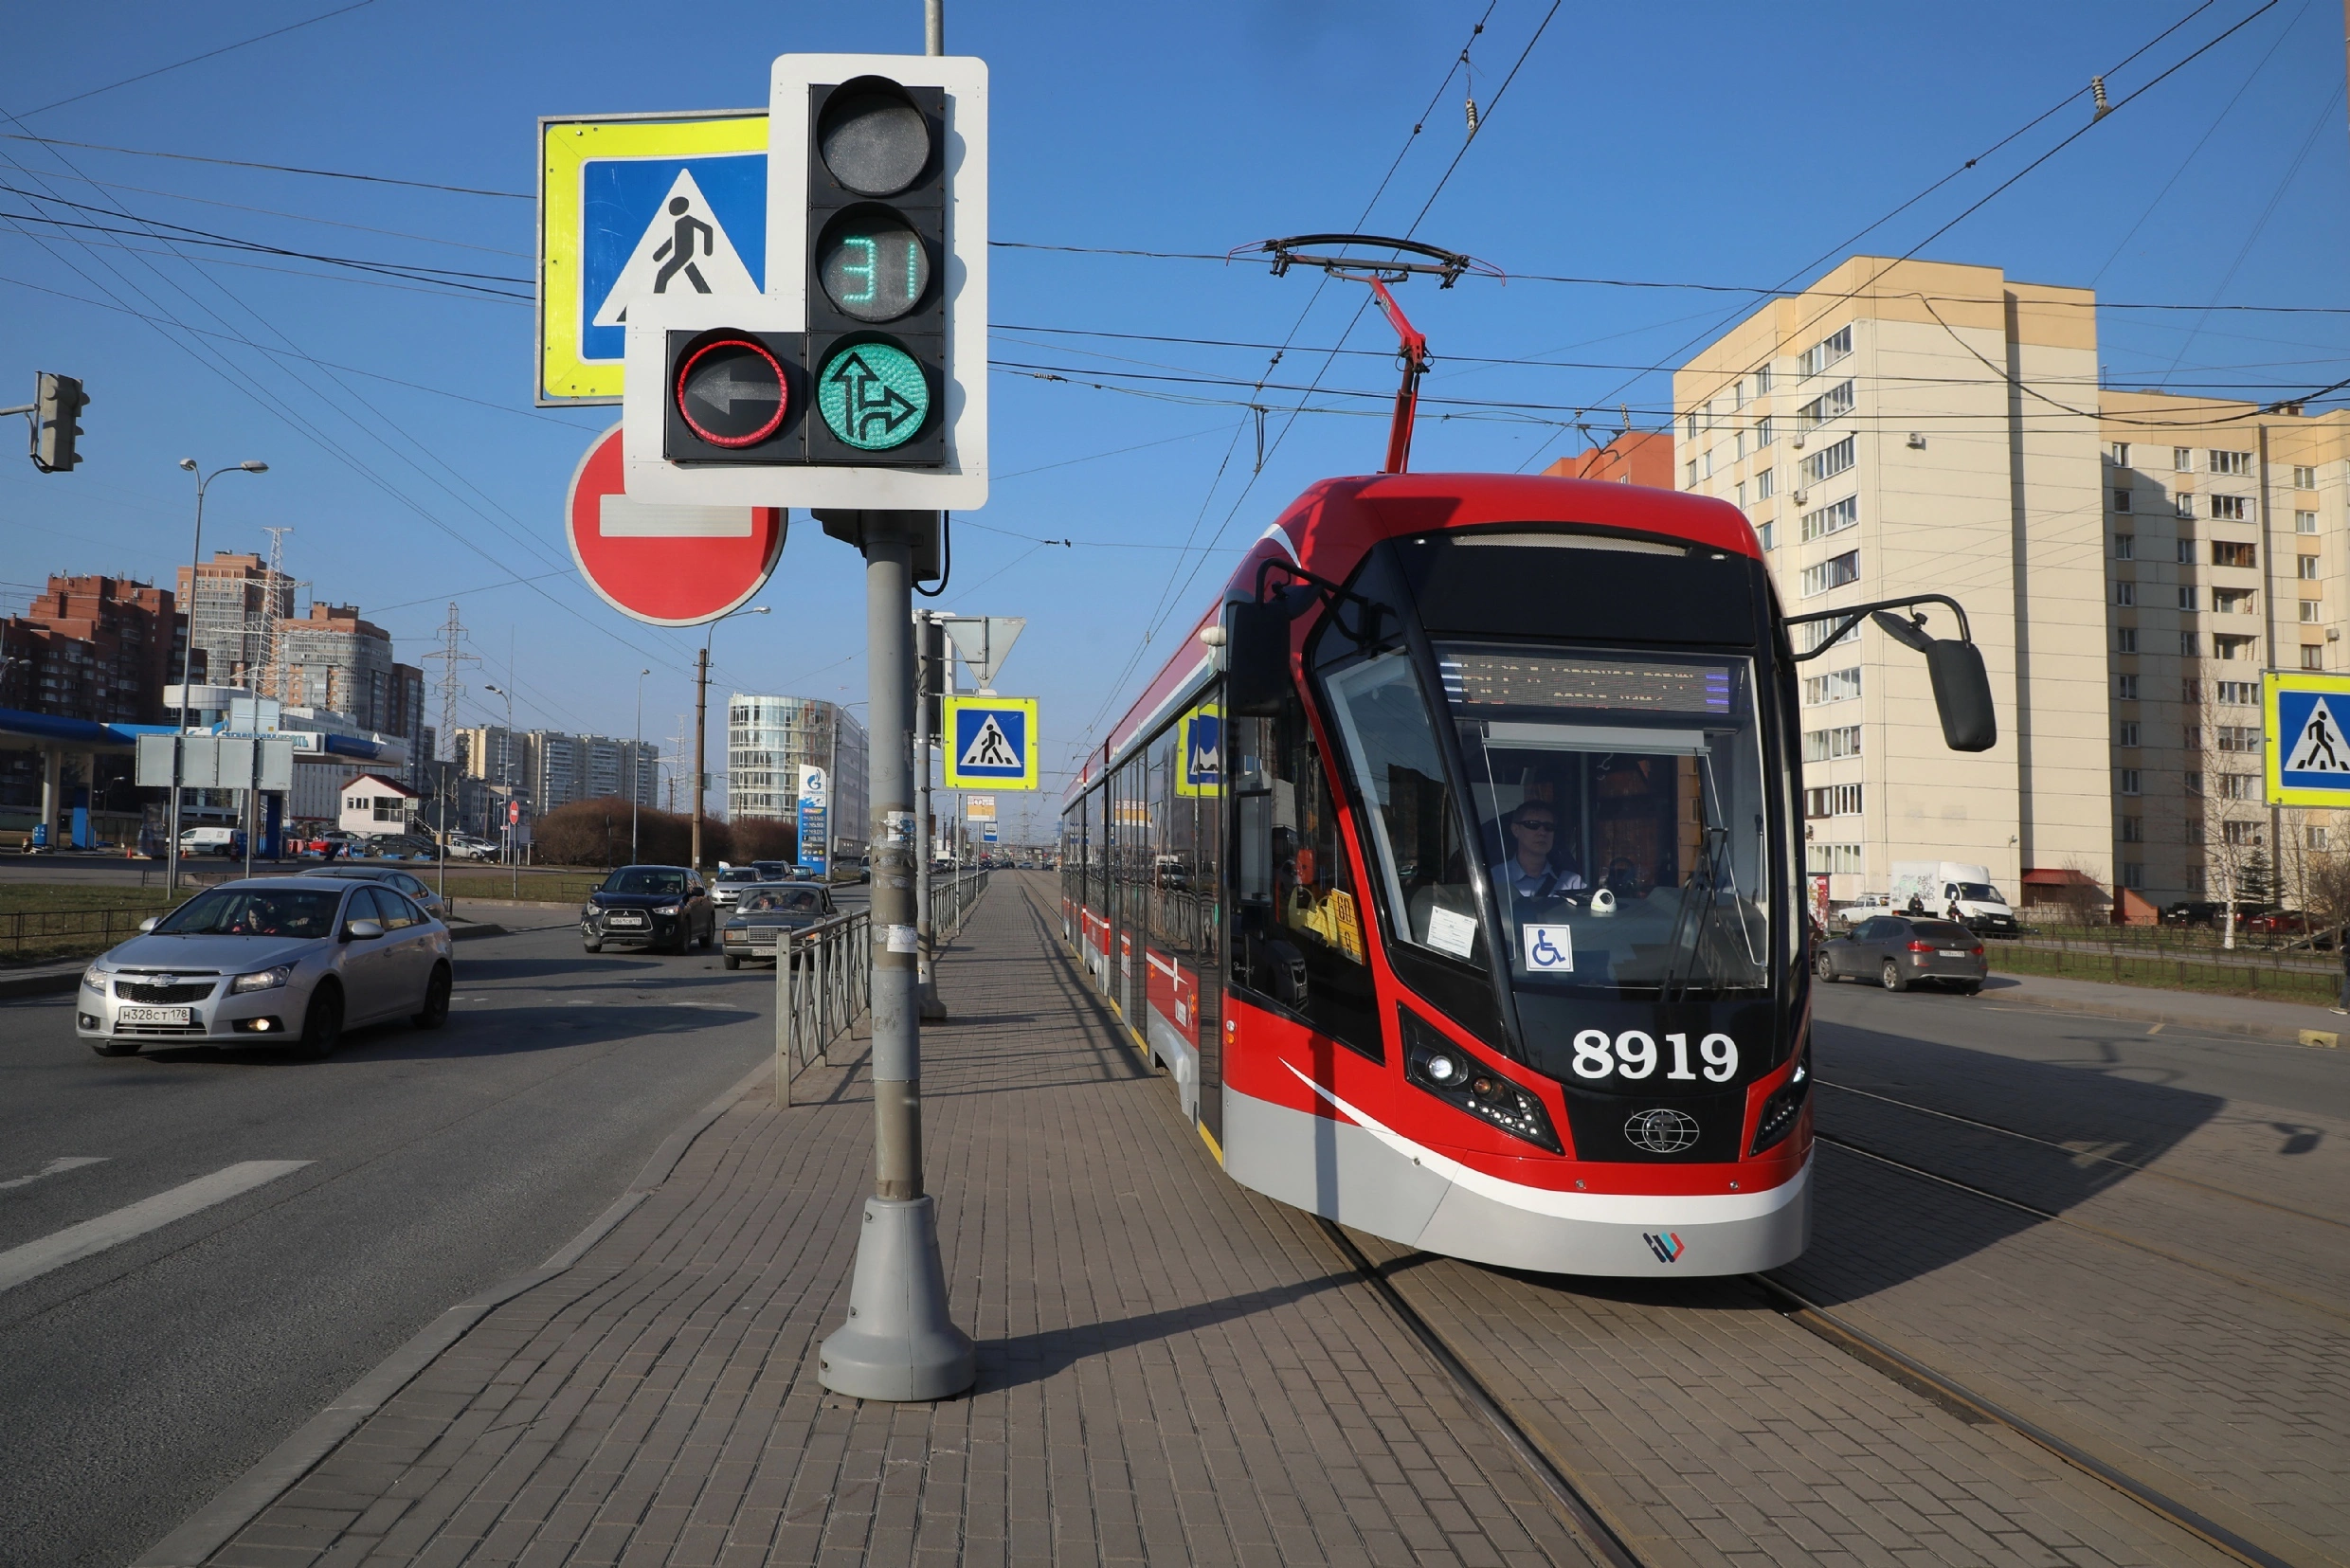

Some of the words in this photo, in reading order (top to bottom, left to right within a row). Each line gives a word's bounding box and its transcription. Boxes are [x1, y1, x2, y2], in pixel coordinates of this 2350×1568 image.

[842, 237, 917, 301] 31
[1337, 895, 1352, 924] 60
[1345, 931, 1353, 956] 9
[123, 1009, 168, 1020] Н328СТ
[171, 1009, 187, 1018] 178
[1572, 1029, 1739, 1083] 8919
